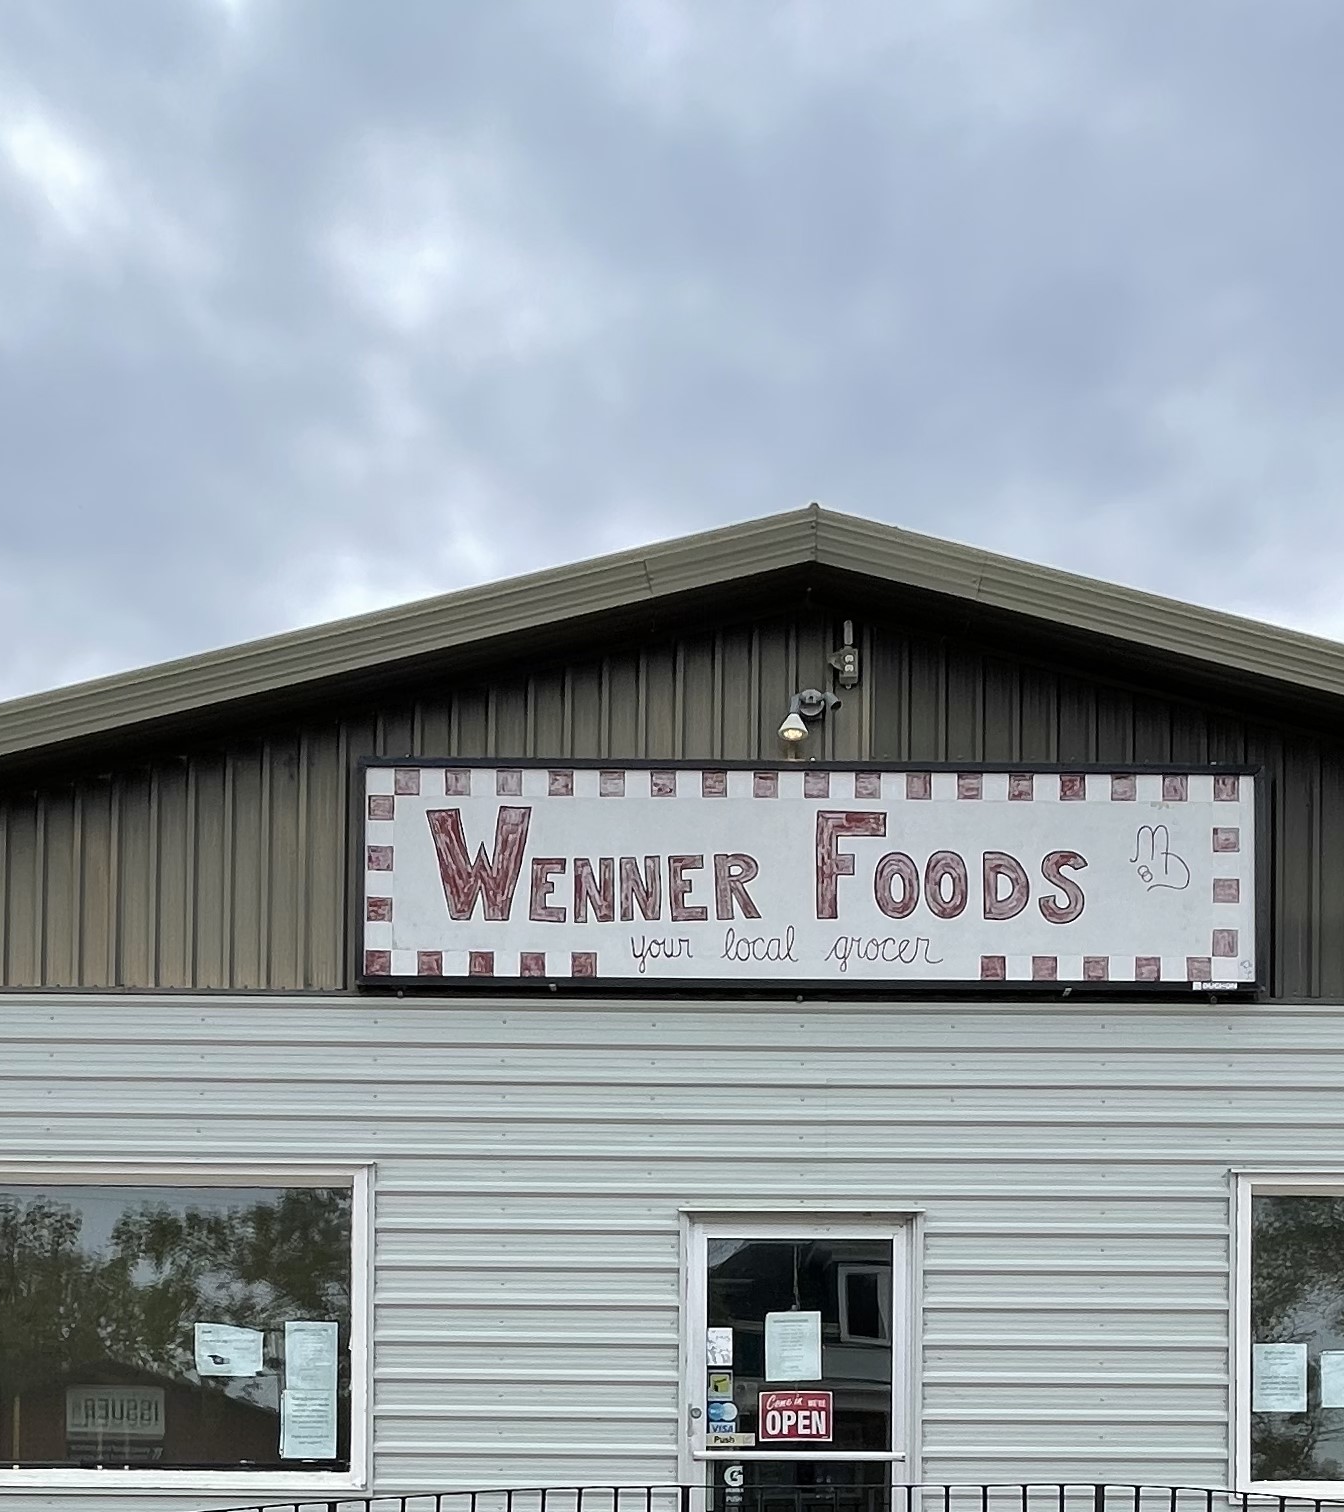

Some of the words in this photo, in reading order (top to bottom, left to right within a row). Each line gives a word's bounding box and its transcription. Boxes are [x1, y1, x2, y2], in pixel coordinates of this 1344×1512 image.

[425, 805, 762, 924] WENNER
[815, 809, 1089, 925] FOODS
[629, 933, 694, 974] your
[719, 924, 799, 963] local
[824, 934, 944, 973] grocer
[766, 1394, 793, 1410] Come
[794, 1393, 804, 1406] in
[711, 1423, 735, 1433] VISA
[765, 1410, 827, 1436] OPEN
[714, 1436, 735, 1444] Push
[724, 1465, 744, 1487] G
